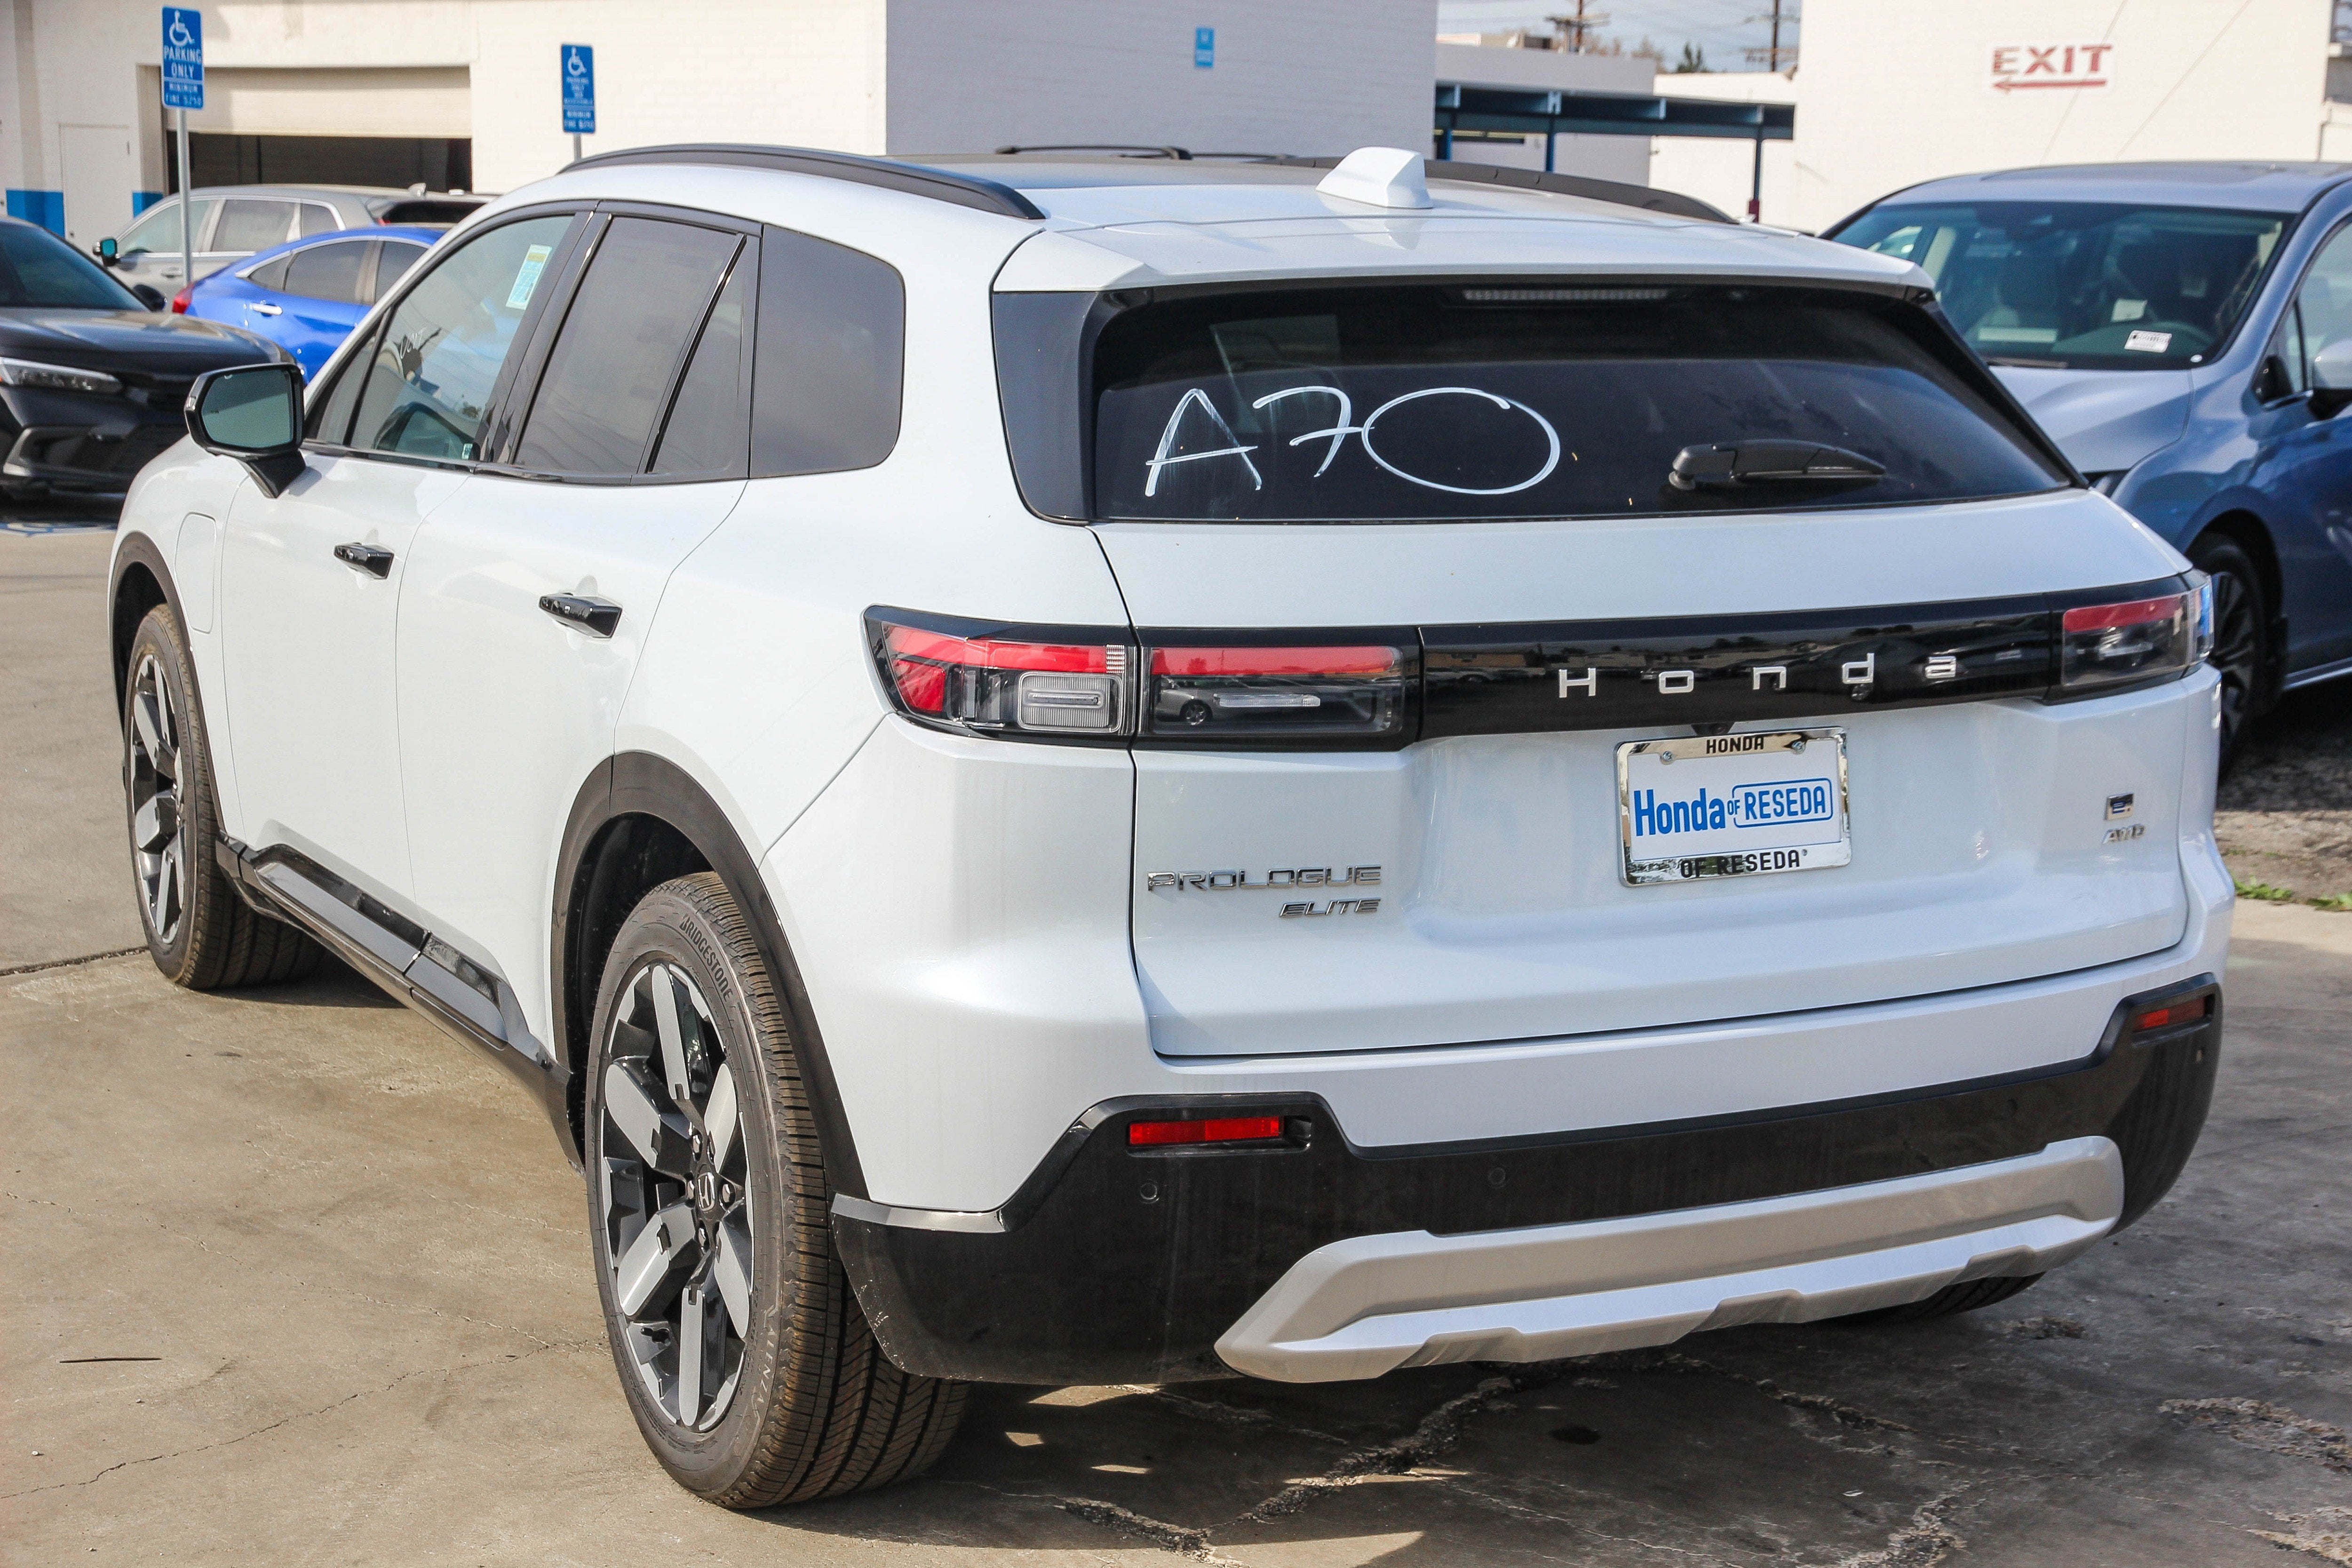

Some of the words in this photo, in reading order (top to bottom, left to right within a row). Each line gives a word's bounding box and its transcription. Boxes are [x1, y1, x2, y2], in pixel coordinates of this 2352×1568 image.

[163, 45, 202, 64] PARKING
[1993, 45, 2113, 74] EXIT
[171, 62, 194, 79] ONLY
[1706, 735, 1764, 754] HONDA
[1634, 788, 1726, 837] Honda
[1727, 799, 1740, 815] OF
[1744, 786, 1826, 820] RESEDA
[1680, 857, 1707, 878] OF
[1716, 849, 1800, 875] RESEDA
[1147, 866, 1381, 891] PROLOGUE
[1279, 897, 1381, 918] ELITE
[679, 913, 733, 1002] BRIDGESTONE
[757, 1325, 776, 1403] ALENZA
